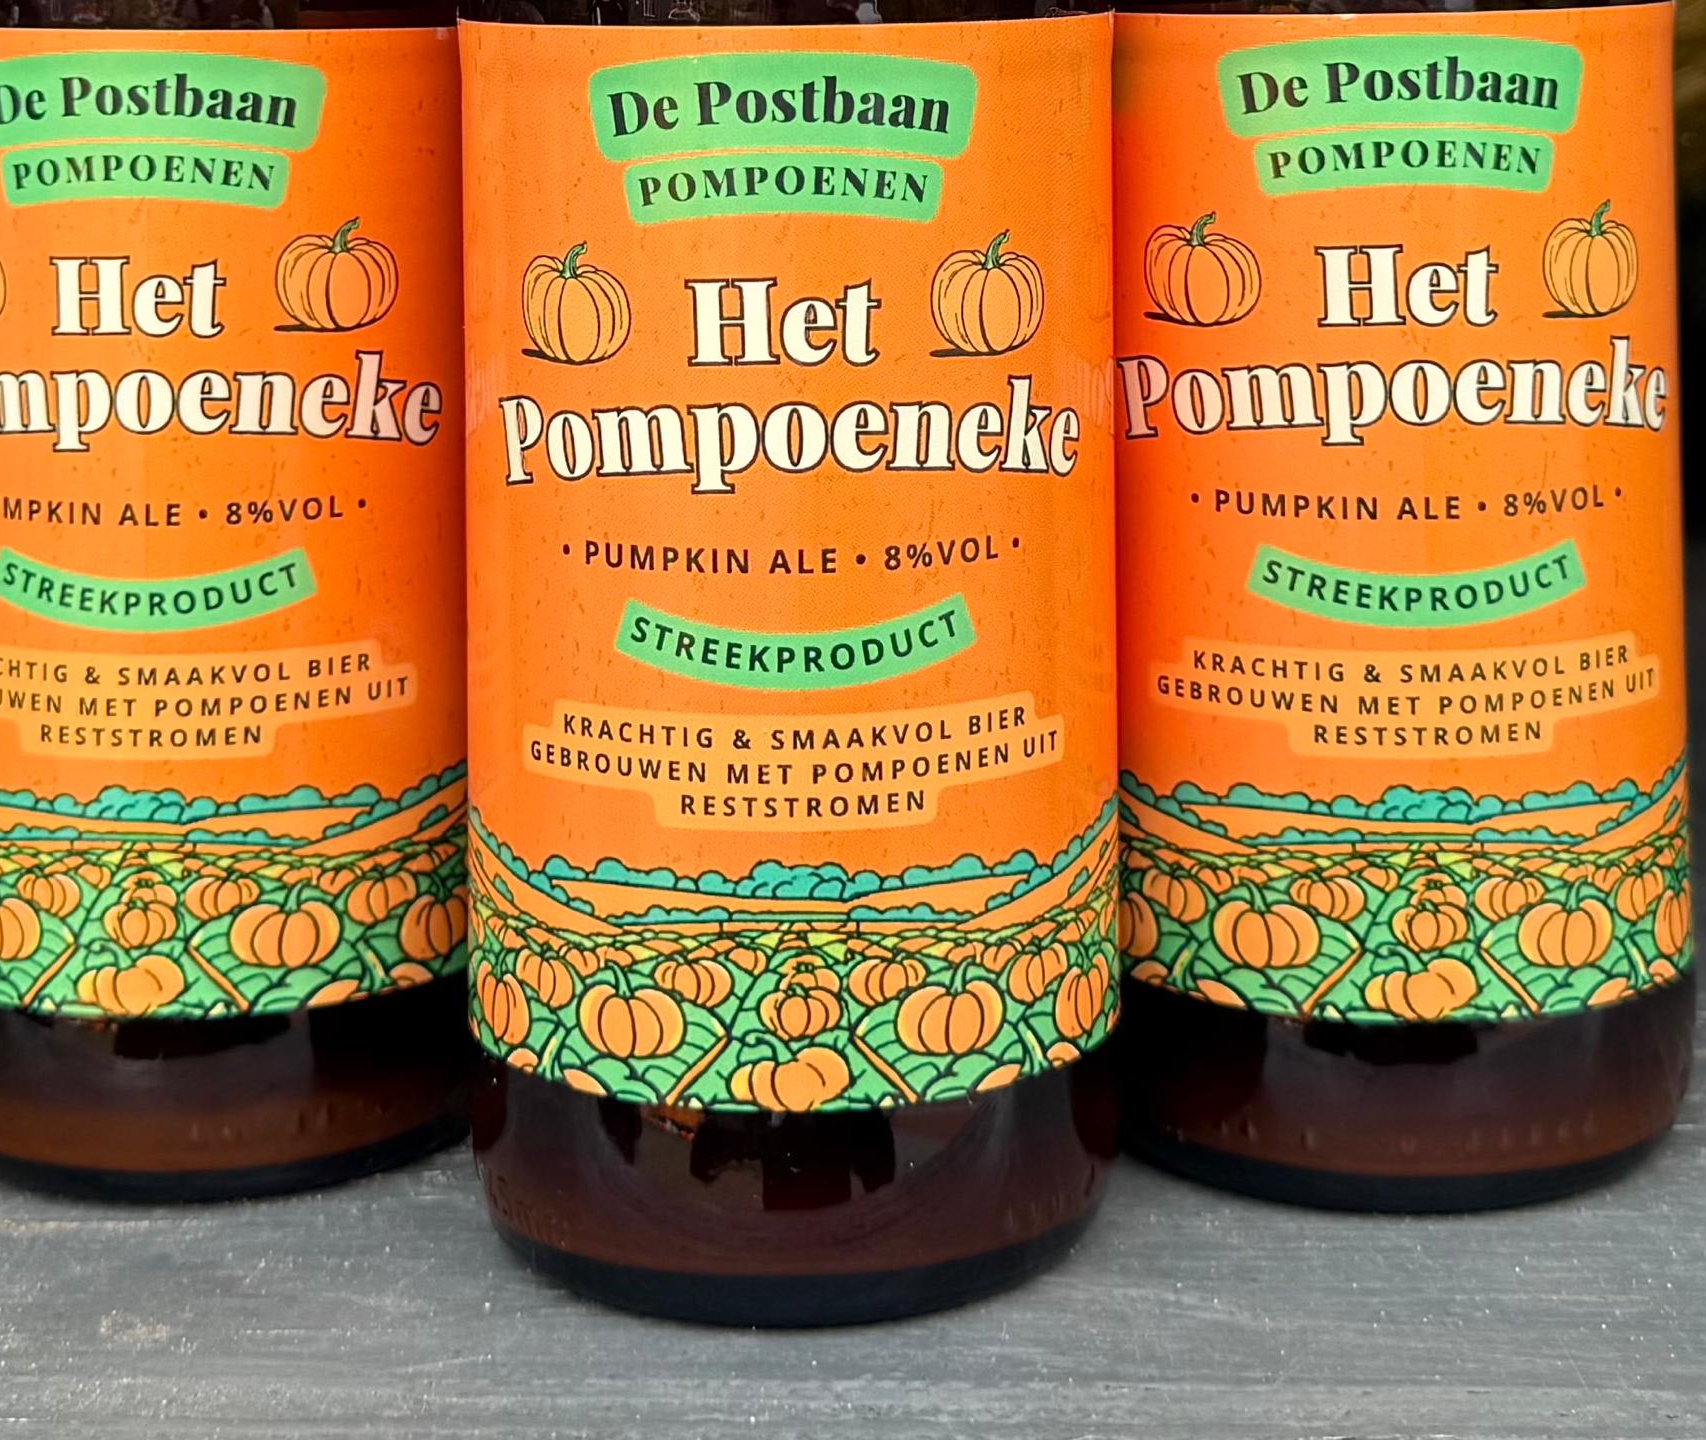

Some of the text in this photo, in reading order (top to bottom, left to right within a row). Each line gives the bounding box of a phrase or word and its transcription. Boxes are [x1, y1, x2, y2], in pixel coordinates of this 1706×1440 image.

[61, 73, 298, 128] Postbaan
[608, 75, 951, 138] De Postbaan
[1237, 56, 1559, 115] De Postbaan
[13, 154, 275, 191] POMPOENEN
[1268, 139, 1541, 180] POMPOENEN
[638, 164, 929, 207] POMPOENEN
[50, 256, 226, 337] Het
[1314, 244, 1498, 327] Het
[684, 278, 881, 367] Het
[1116, 335, 1669, 447] Pompoeneke
[499, 375, 1080, 496] Pompoeneke
[119, 502, 182, 526] ALE
[226, 495, 344, 525] 8%VOL
[1215, 485, 1605, 521] PUMPKIN ALE 8%VOL
[585, 535, 999, 575] PUMPKIN ALE 8%VOL
[3, 561, 299, 617] STREEKPRODUCT
[1262, 554, 1571, 612] STREEKPRODUCT
[630, 610, 958, 674] STREEKPRODUCT
[1193, 644, 1628, 684] KRACHTIG & SMAAKVOL BIER
[84, 666, 101, 684] &
[118, 661, 291, 686] SMAAKVOL
[308, 653, 371, 678] BIER
[1157, 668, 1655, 716] GEBROUWEN MET POMPOENEN UIT
[79, 696, 137, 717] MET
[154, 686, 352, 717] POMPOENEN
[367, 676, 409, 701] UIT
[40, 724, 262, 748] RESTSTROMEN
[563, 706, 1027, 751] KRACHTIG & SMAAKVOL BIER
[1313, 721, 1542, 746] RESTSTROMEN
[530, 729, 1060, 786] GEBROUWEN MET POMPOENEN UIT
[680, 790, 927, 819] RESTSTROMEN
